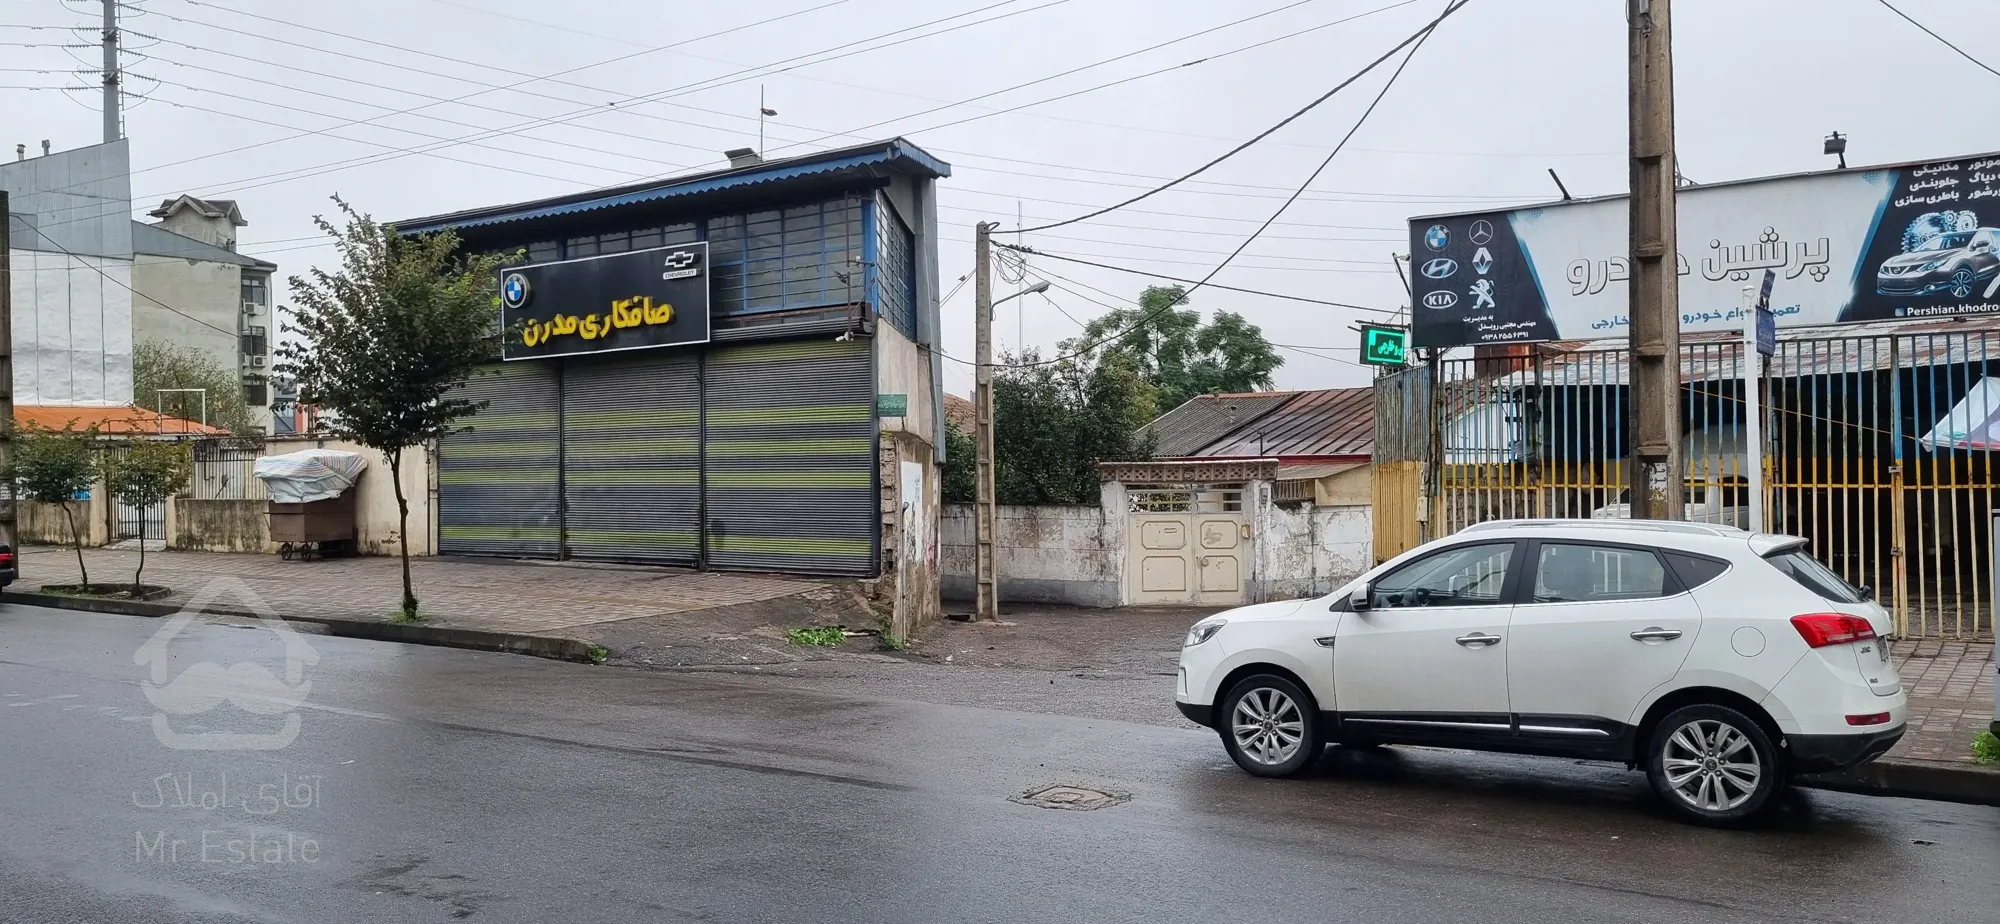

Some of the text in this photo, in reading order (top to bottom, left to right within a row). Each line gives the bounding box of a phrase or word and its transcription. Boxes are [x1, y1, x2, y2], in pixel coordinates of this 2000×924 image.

[1912, 162, 1959, 177] مکانیکی
[1909, 177, 1959, 192] جلوبندی
[1894, 190, 1959, 208] باطری سازی
[1702, 226, 1830, 282] پرشین
[664, 270, 695, 278] CHEVROLET
[1682, 309, 1722, 324] خودرو
[1906, 303, 2000, 316] Pershian.khodro
[523, 296, 675, 347] صافکاری مدرن
[1591, 315, 1630, 330] خارجی
